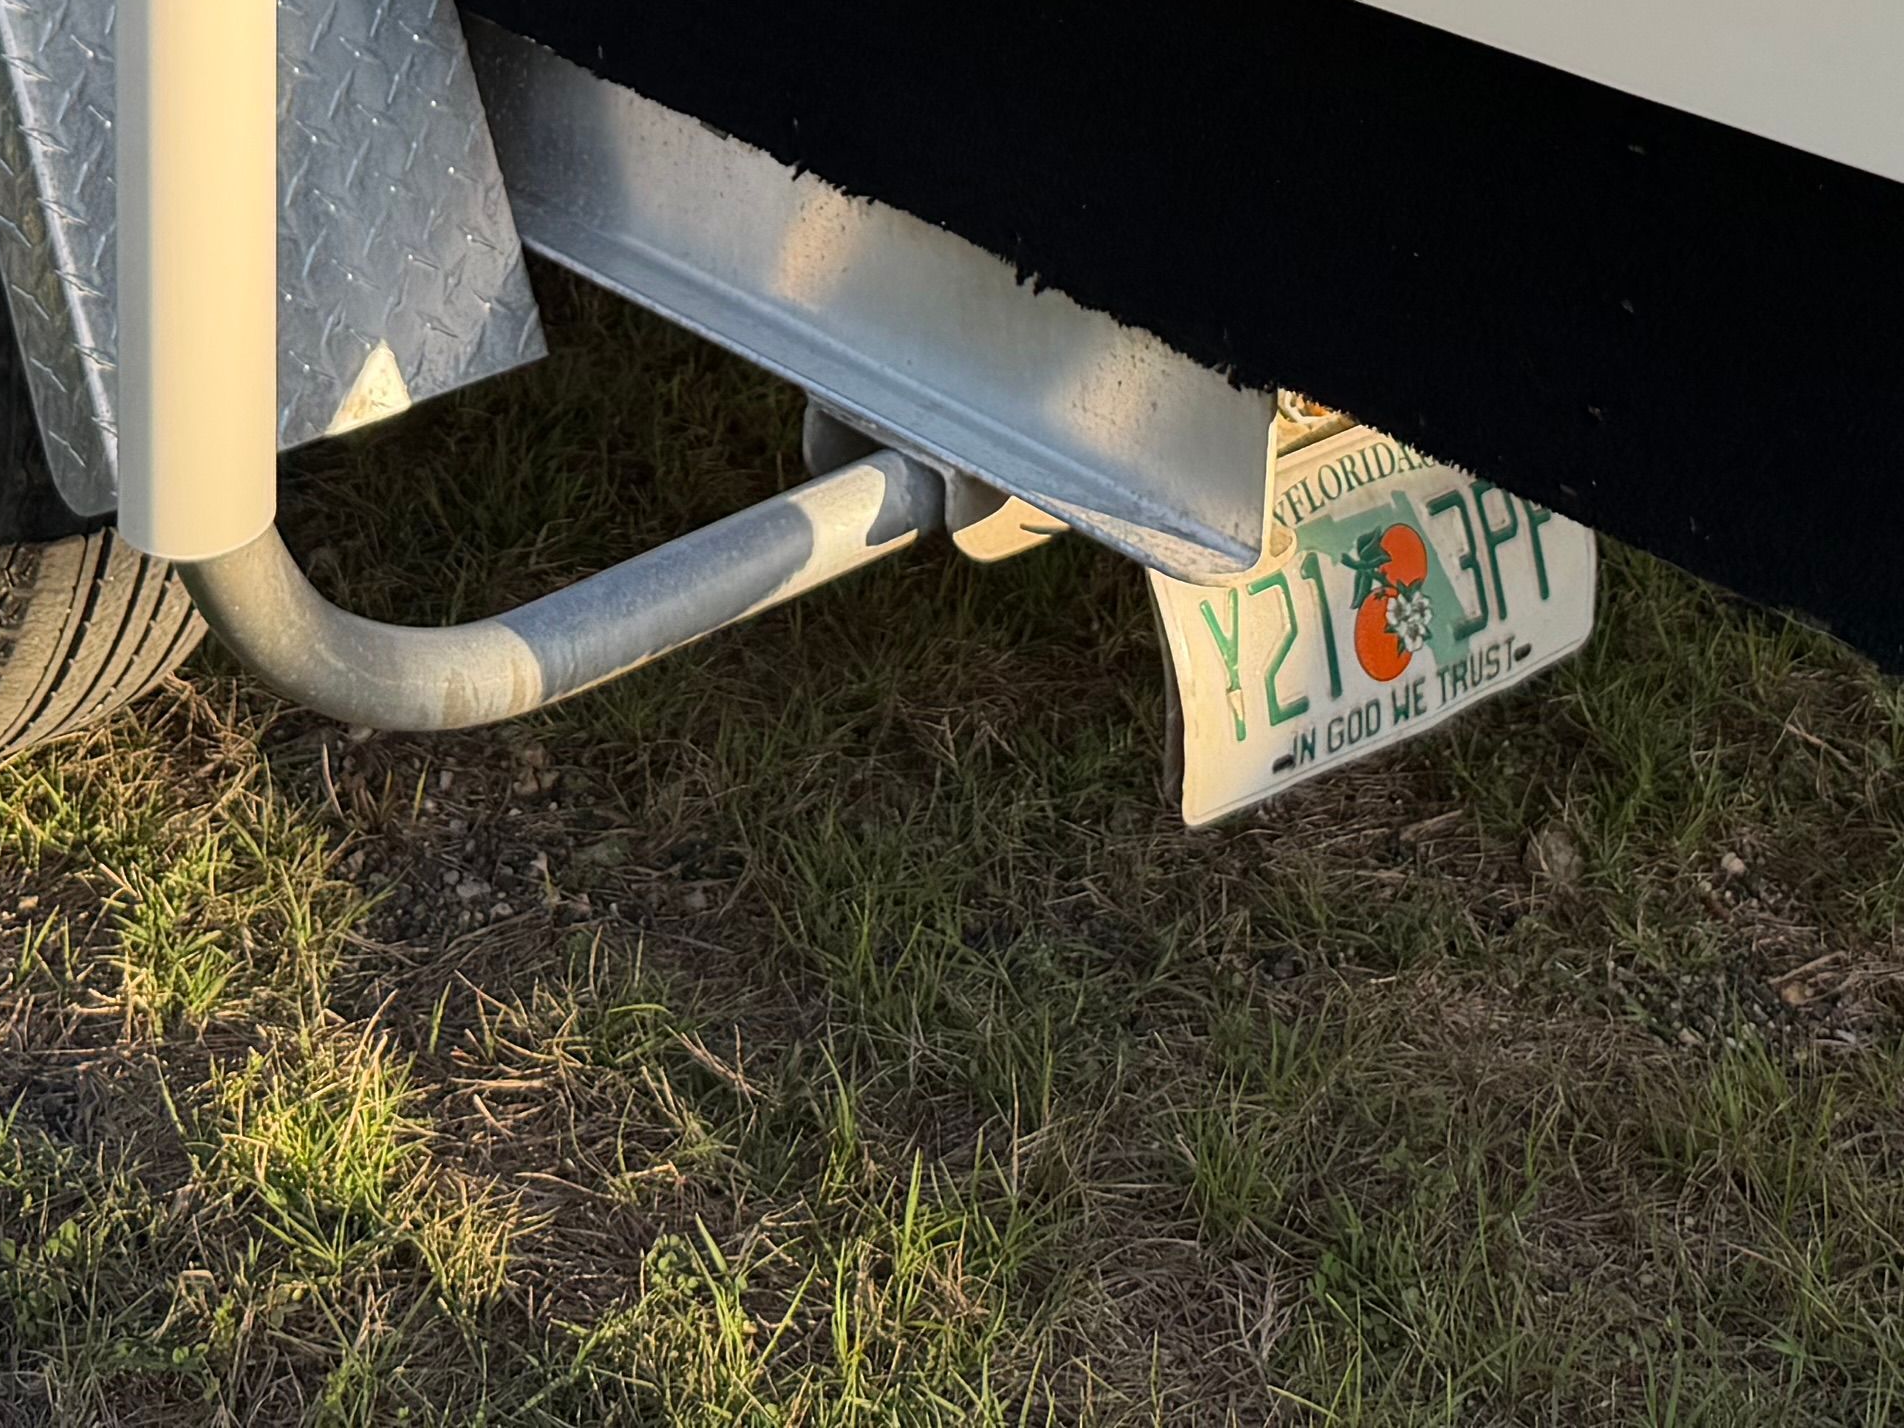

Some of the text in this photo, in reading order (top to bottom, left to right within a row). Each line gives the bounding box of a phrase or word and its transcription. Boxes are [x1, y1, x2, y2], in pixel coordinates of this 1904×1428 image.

[1199, 551, 1343, 743] Y21
[1291, 635, 1515, 769] IN GOD WE TRUST
